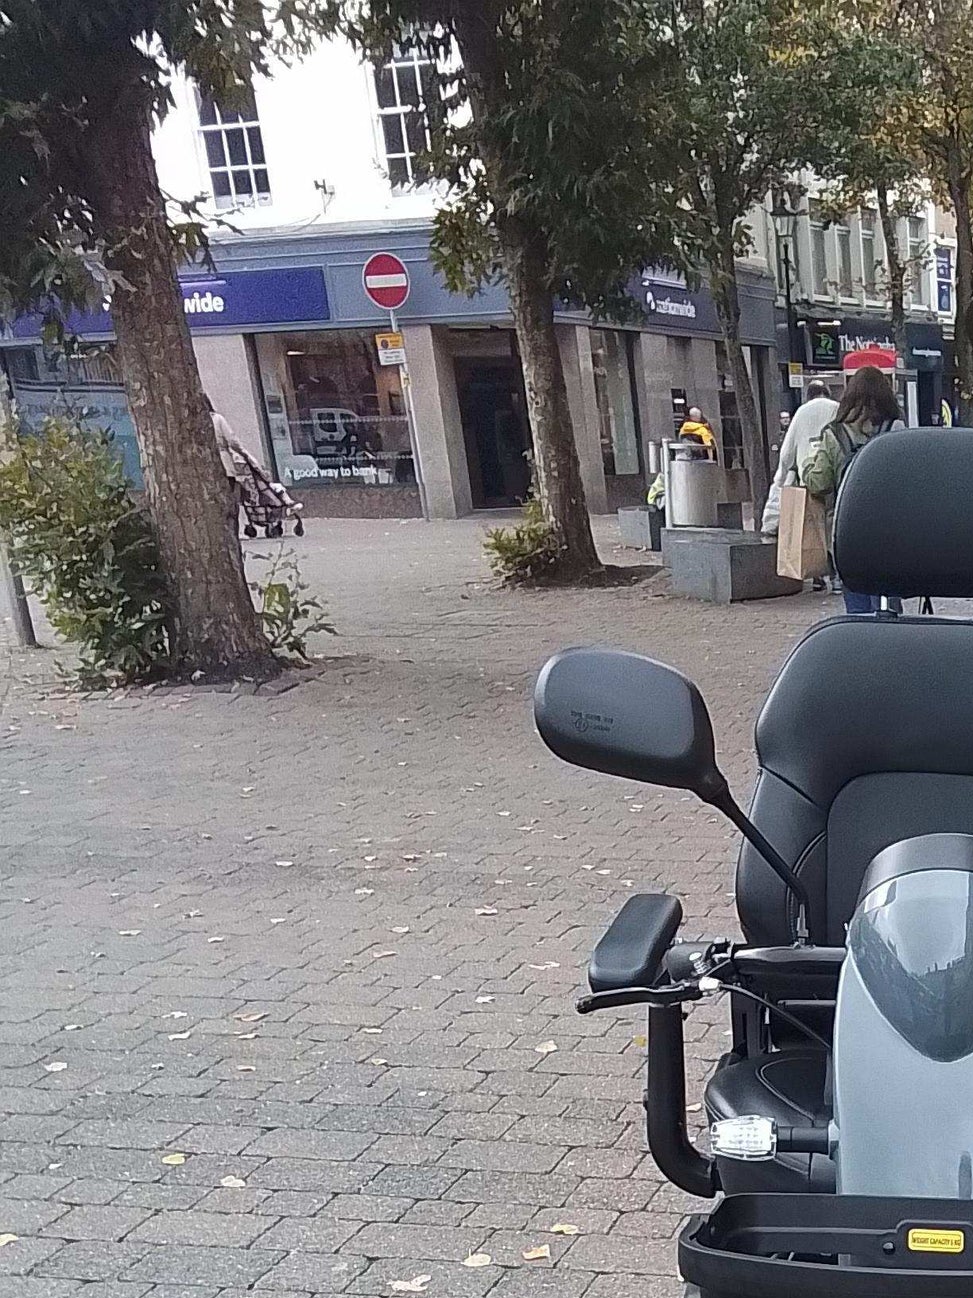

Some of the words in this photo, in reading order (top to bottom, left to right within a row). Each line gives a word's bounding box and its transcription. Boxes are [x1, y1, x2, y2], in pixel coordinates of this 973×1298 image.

[838, 334, 855, 352] The
[292, 466, 318, 481] good
[319, 468, 339, 480] way
[340, 466, 351, 477] to
[352, 464, 378, 477] bank
